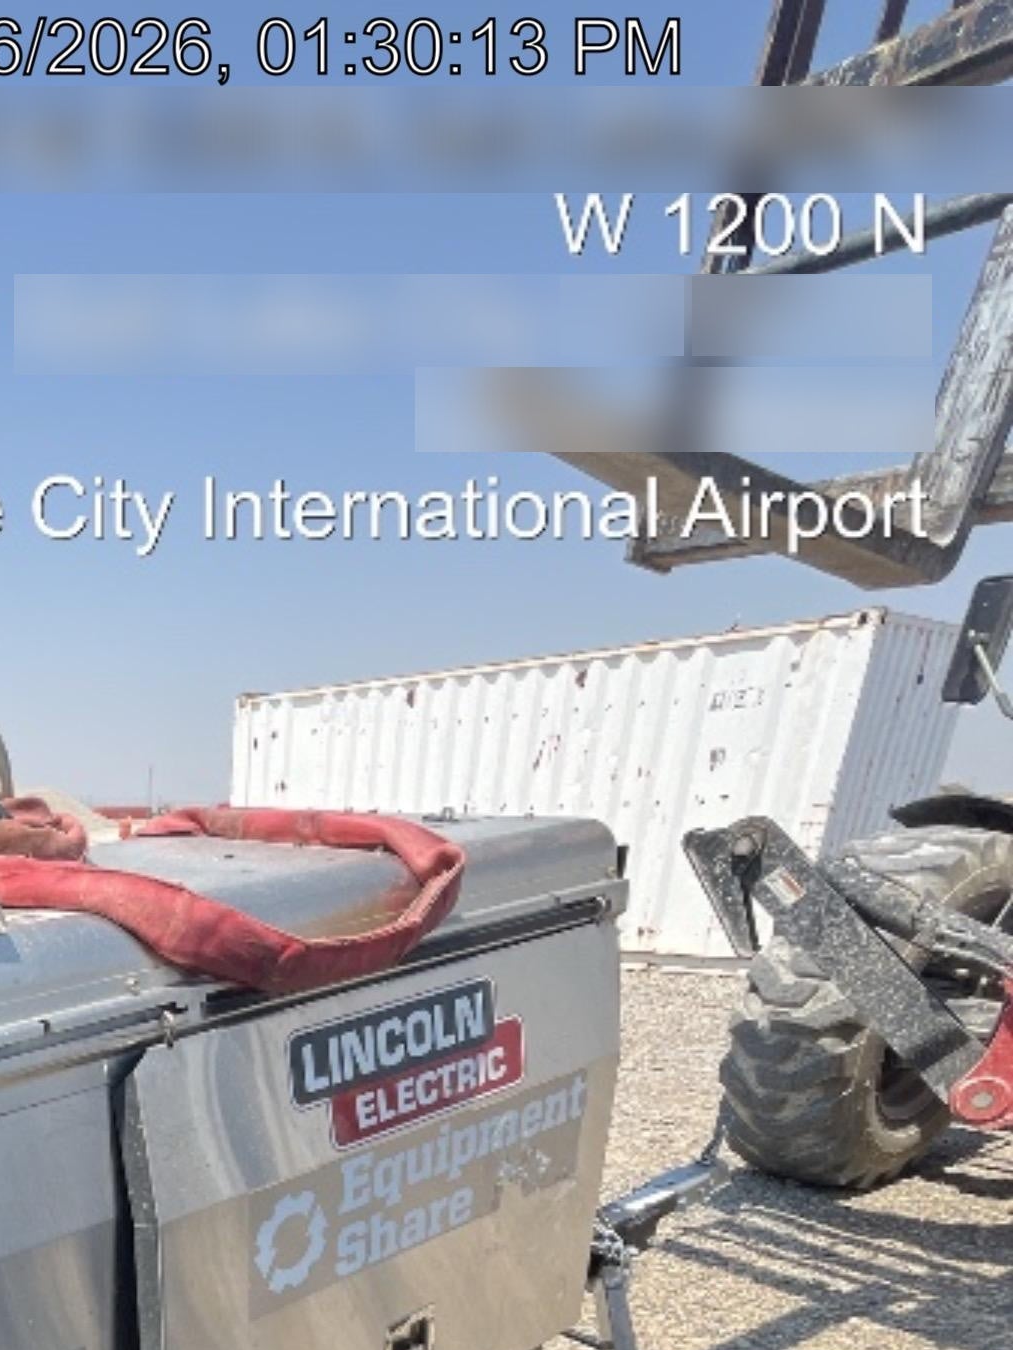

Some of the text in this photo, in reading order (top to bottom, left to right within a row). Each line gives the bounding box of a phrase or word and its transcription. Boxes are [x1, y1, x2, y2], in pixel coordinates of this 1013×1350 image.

[301, 991, 487, 1093] LINCOLN
[354, 1046, 508, 1131] ELECTRIC
[338, 1073, 588, 1215] Equipment
[334, 1186, 476, 1278] Share
